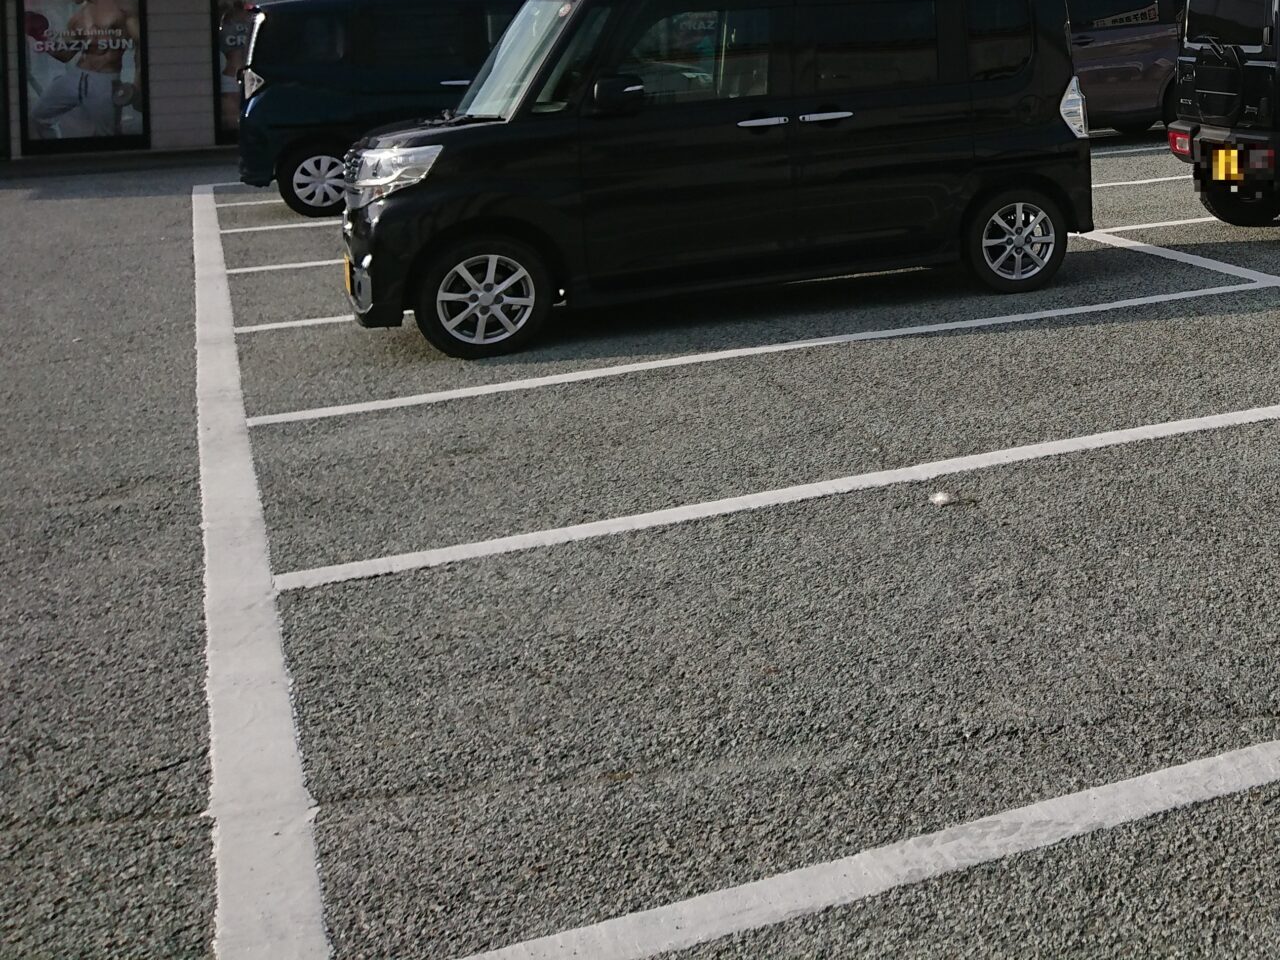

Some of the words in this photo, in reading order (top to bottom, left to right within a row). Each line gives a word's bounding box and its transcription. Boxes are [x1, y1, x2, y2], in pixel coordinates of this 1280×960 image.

[679, 20, 716, 31] CRAZ
[33, 39, 92, 53] CRAZY
[97, 38, 134, 51] SUN
